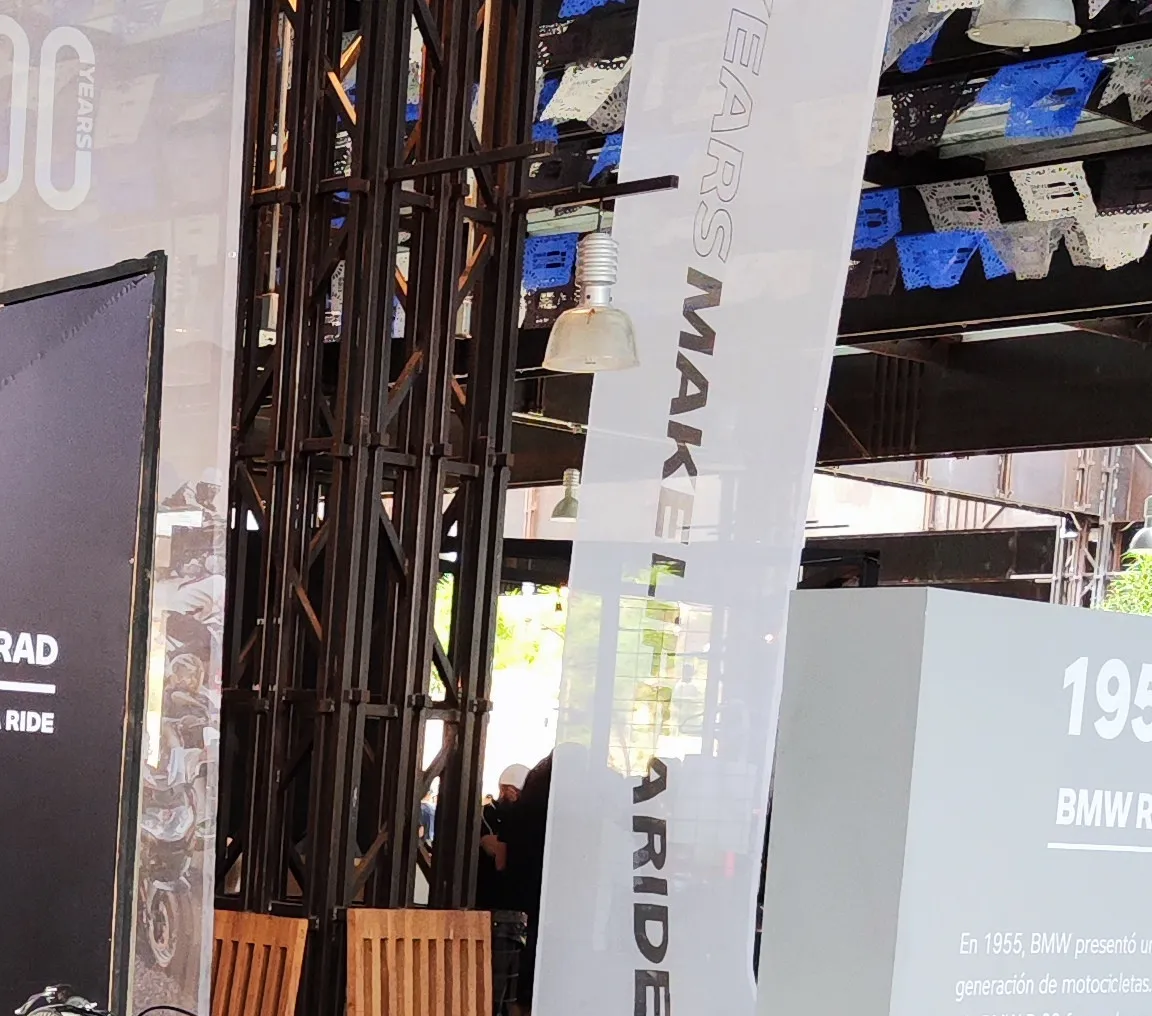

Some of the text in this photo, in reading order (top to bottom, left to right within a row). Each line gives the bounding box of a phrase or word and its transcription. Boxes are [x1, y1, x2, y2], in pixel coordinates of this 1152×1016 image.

[75, 65, 96, 150] YEARS
[655, 266, 723, 546] MAKE
[5, 709, 55, 735] RIDE
[632, 756, 667, 804] A
[1055, 787, 1134, 828] BMW
[959, 931, 978, 955] En
[984, 931, 1025, 958] 1955,
[1030, 931, 1072, 954] BMW
[1074, 931, 1137, 960] presentó
[955, 972, 1152, 1002] generación de motocicletas.
